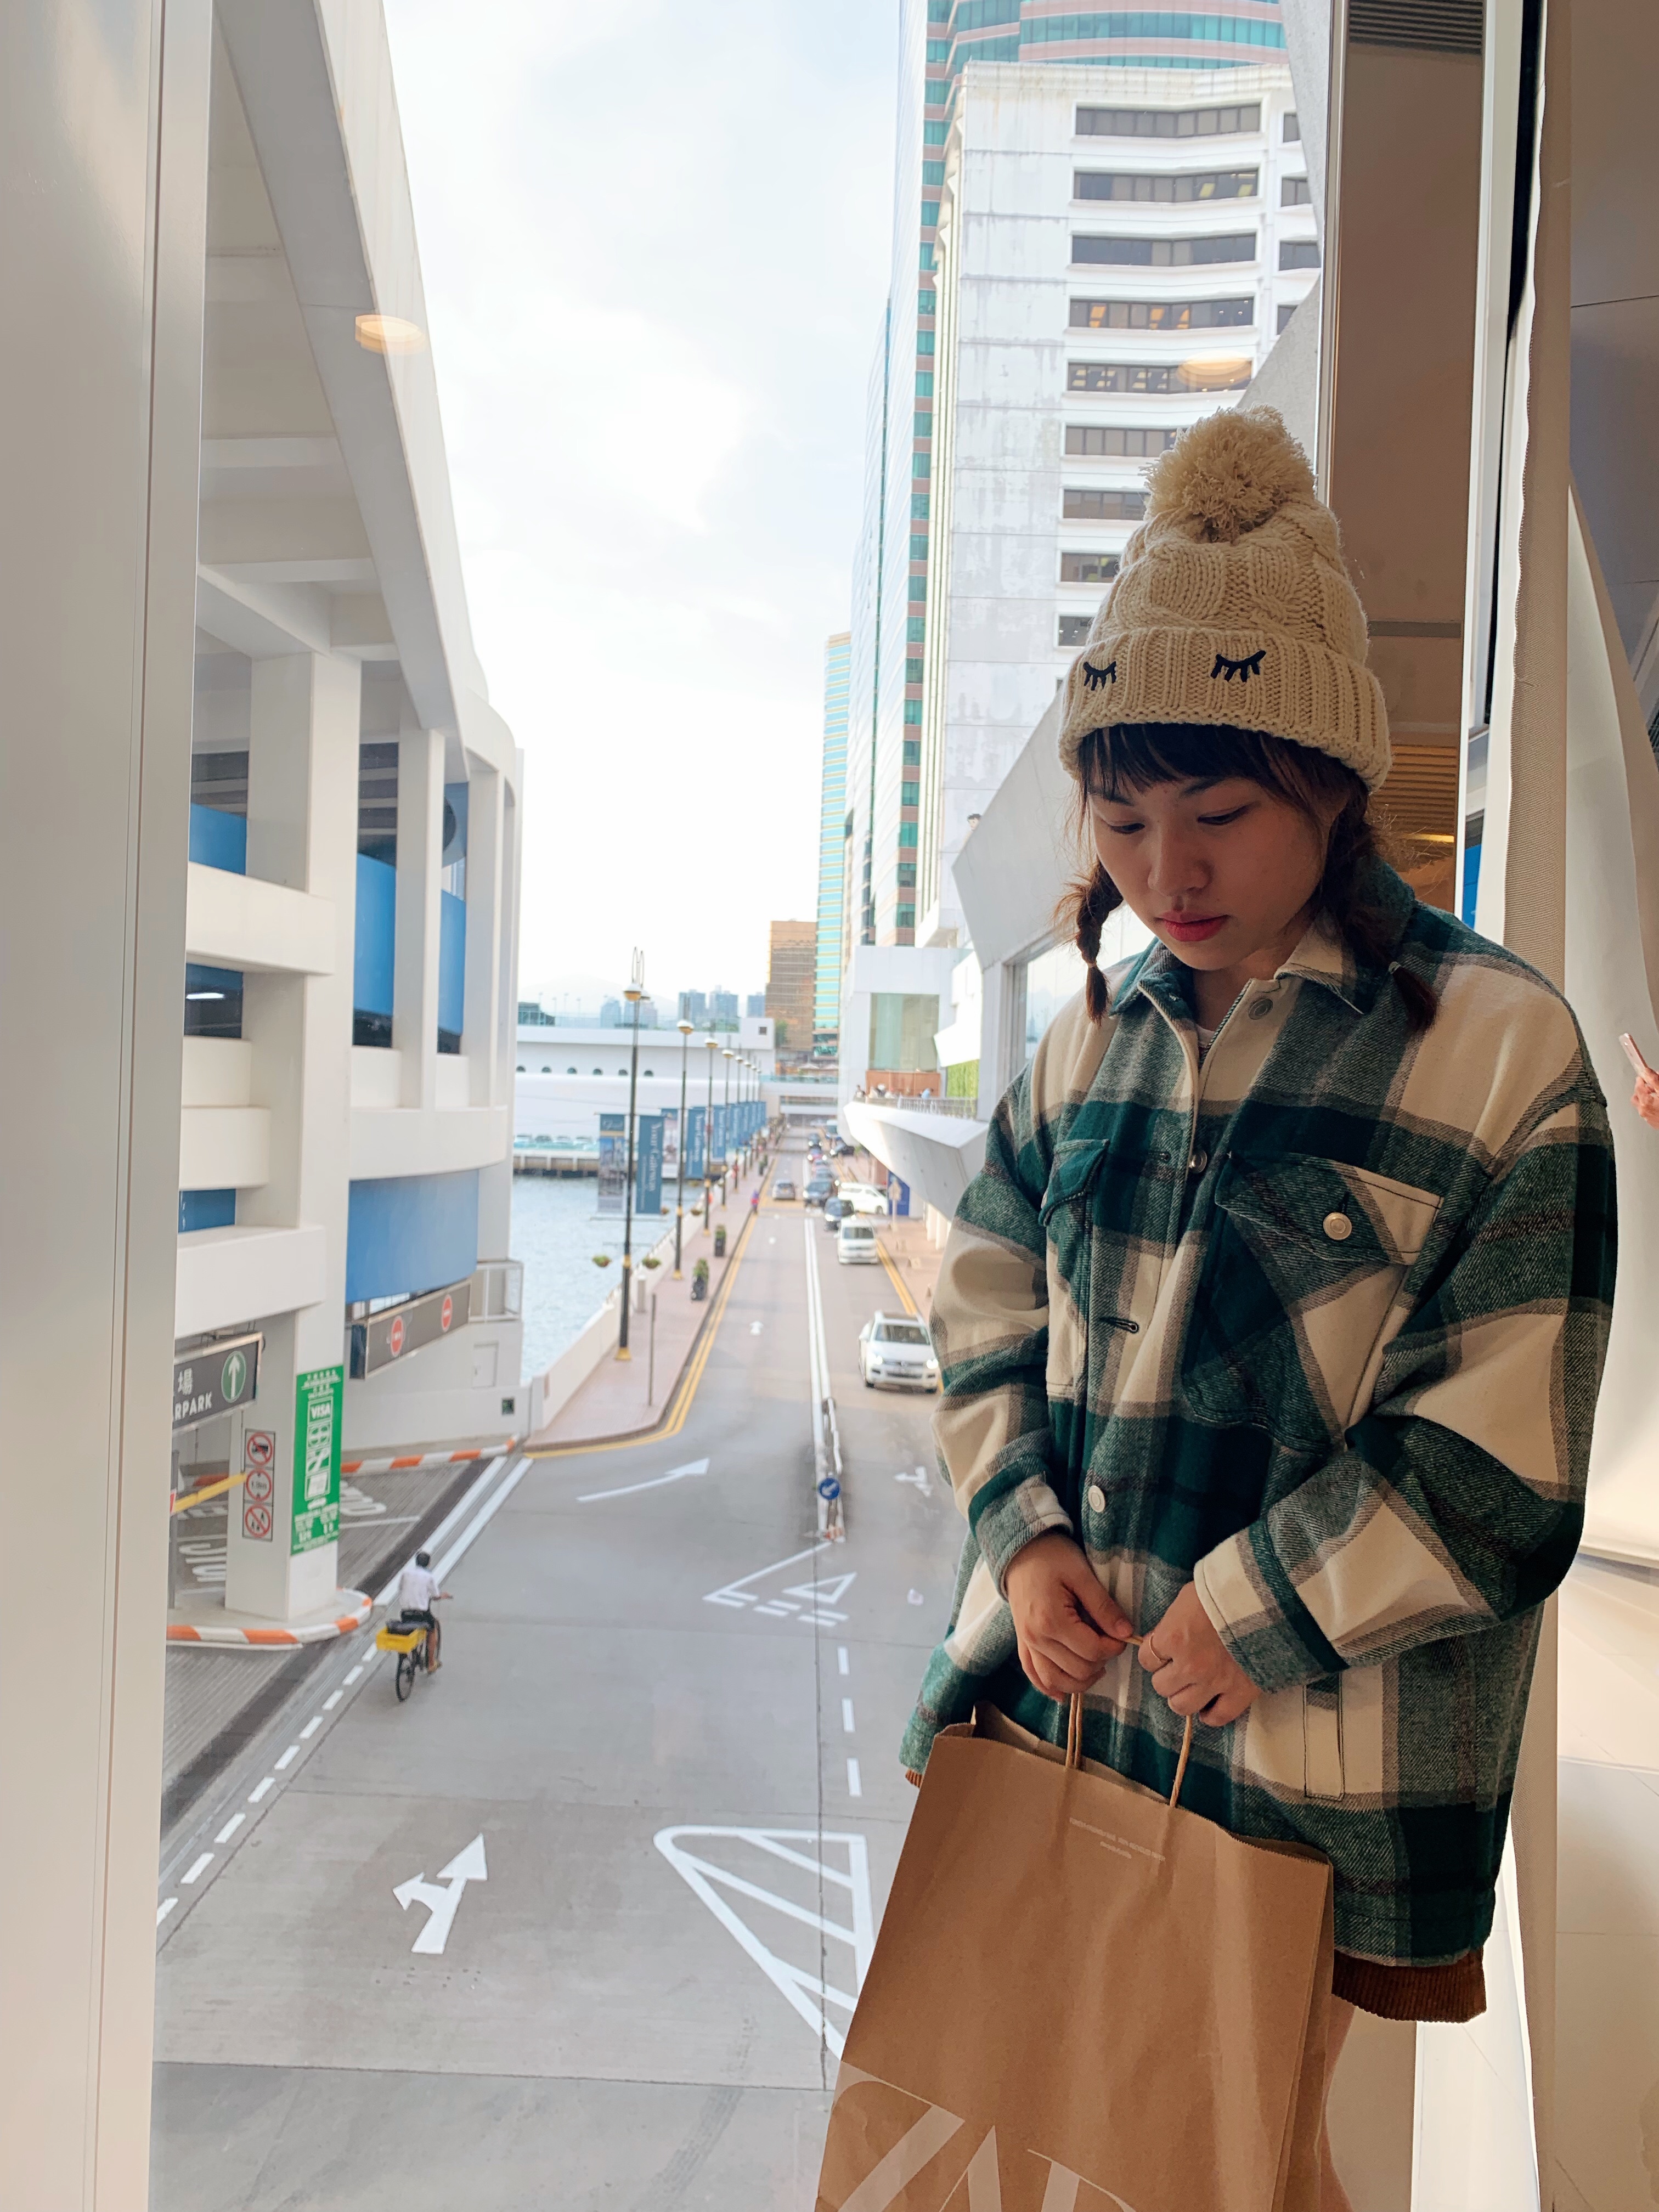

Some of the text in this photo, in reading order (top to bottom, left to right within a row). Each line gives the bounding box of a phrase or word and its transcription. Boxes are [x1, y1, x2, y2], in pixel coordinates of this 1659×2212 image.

[177, 1368, 192, 1395] 場
[174, 1391, 212, 1421] RPARK
[311, 1403, 331, 1419] VISA
